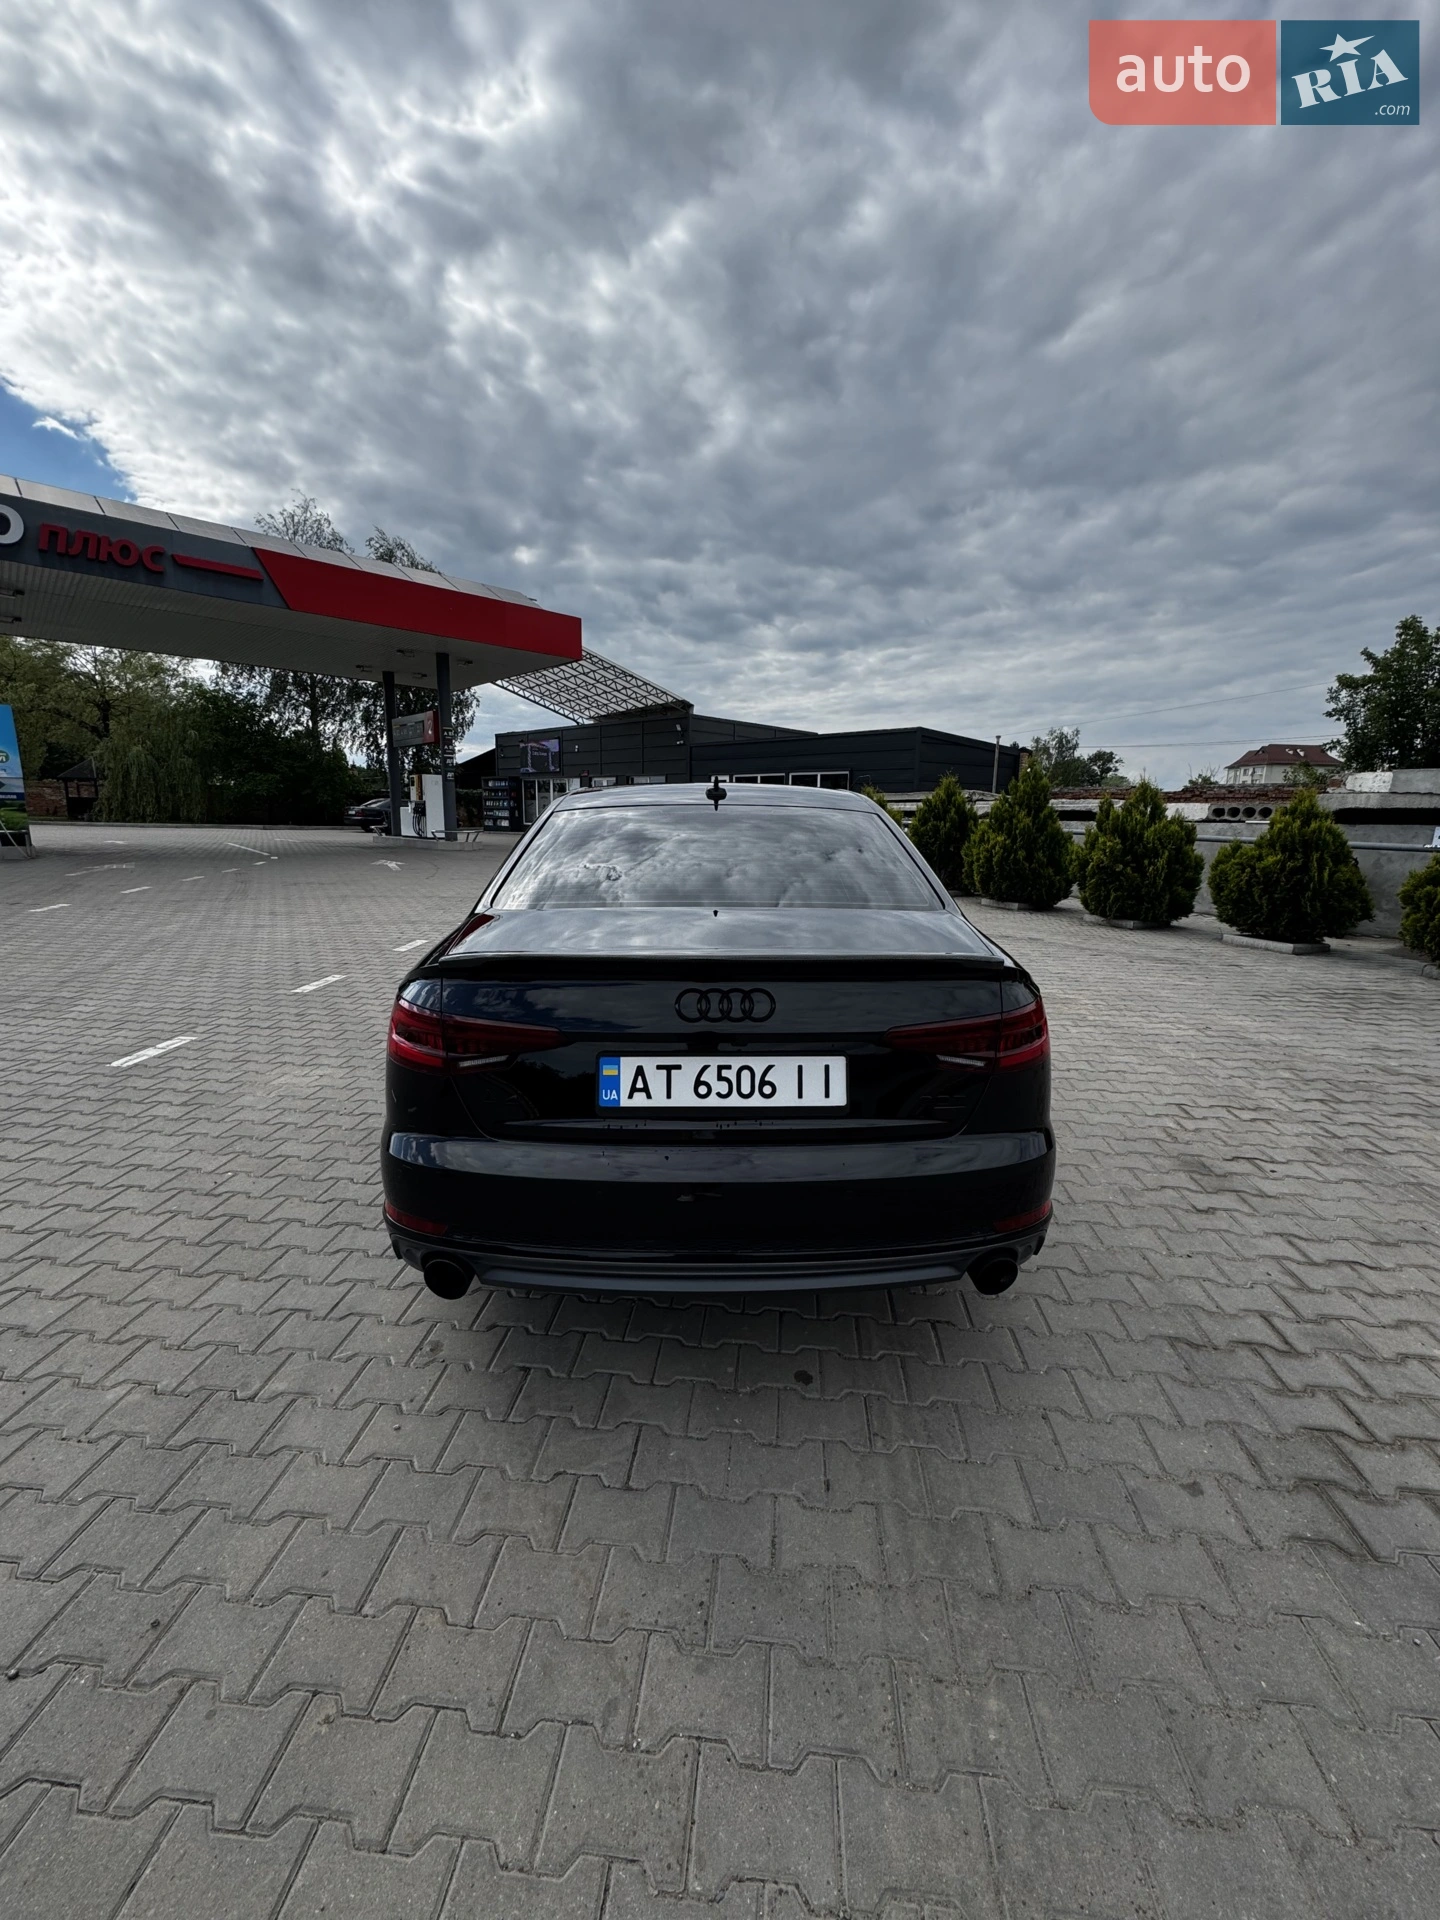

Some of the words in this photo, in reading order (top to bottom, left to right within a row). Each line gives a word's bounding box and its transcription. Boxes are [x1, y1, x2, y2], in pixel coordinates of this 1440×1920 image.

[627, 1064, 683, 1100] AT
[693, 1064, 778, 1099] 6506
[602, 1089, 619, 1101] UA
